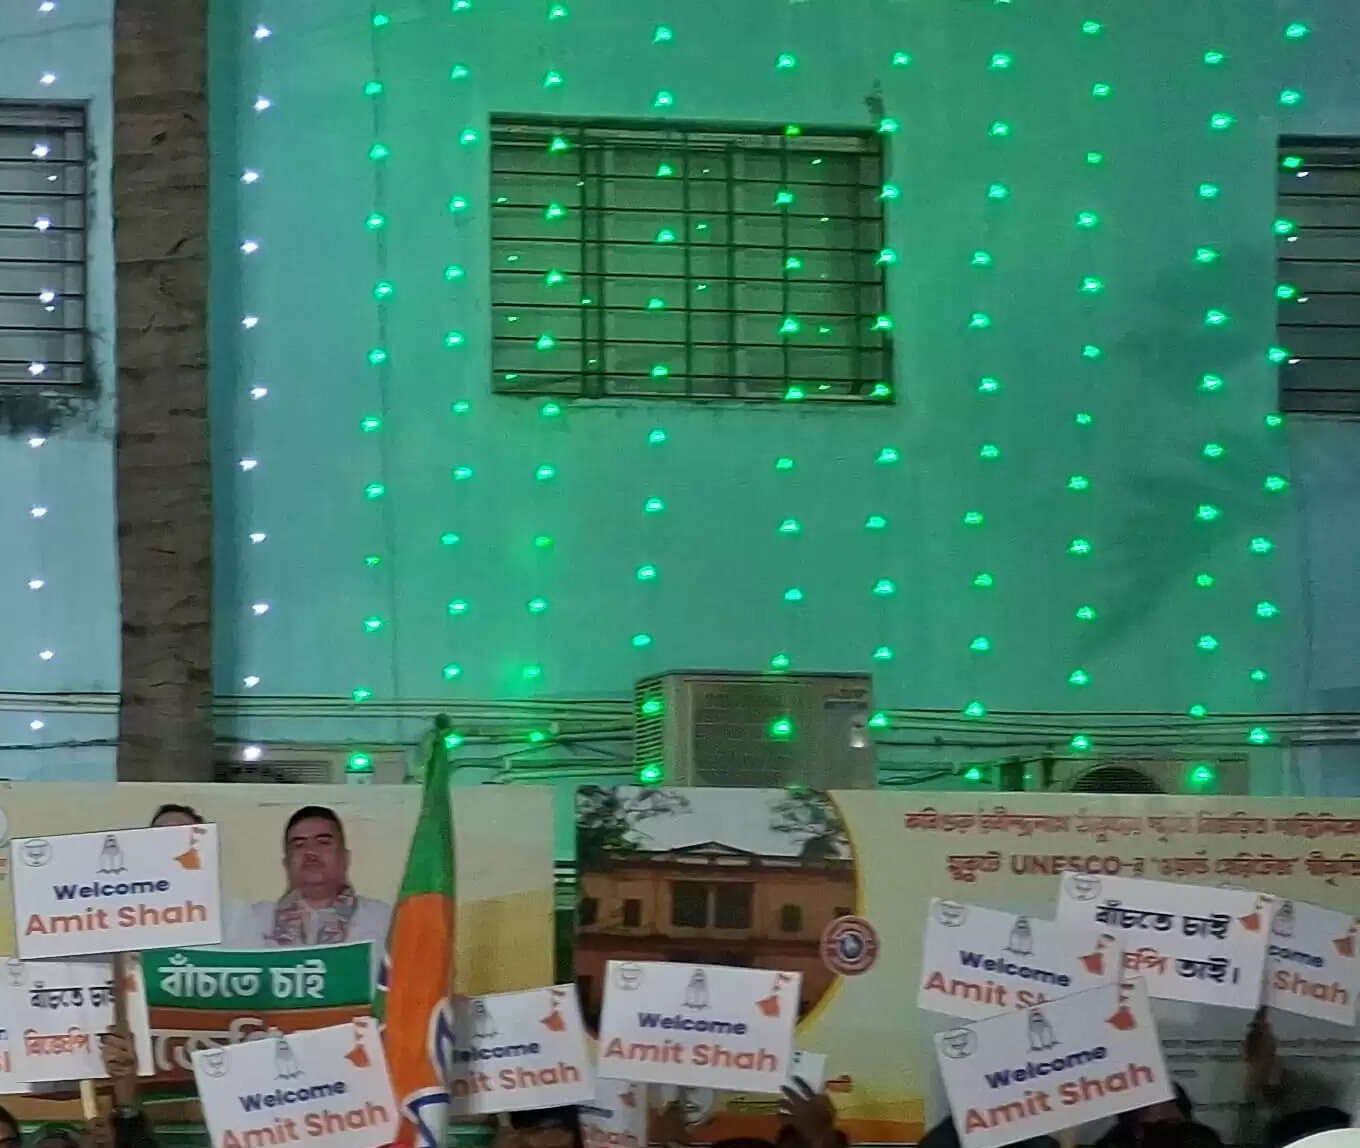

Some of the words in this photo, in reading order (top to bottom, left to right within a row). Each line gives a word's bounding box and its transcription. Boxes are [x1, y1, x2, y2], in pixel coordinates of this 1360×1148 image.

[53, 876, 170, 901] Welcome
[25, 906, 110, 937] Amit
[118, 900, 208, 929] Shah
[1095, 901, 1174, 931] বাঁচতে
[1181, 913, 1231, 940] চাই
[157, 953, 263, 998] বাঁচতে
[269, 959, 327, 1000] চাই
[959, 950, 1071, 987] Welcome
[1273, 969, 1350, 1005] Shah
[923, 971, 1008, 1010] Amit
[637, 1012, 748, 1035] Welcome
[604, 1036, 683, 1065] Amit
[693, 1044, 778, 1073] Shah
[985, 1044, 1108, 1089] Welcome
[498, 1062, 580, 1091] Shah
[238, 1078, 348, 1113] Welcome
[964, 1093, 1051, 1135] Amit
[1061, 1062, 1154, 1104] Shah
[303, 1101, 390, 1140] Shah
